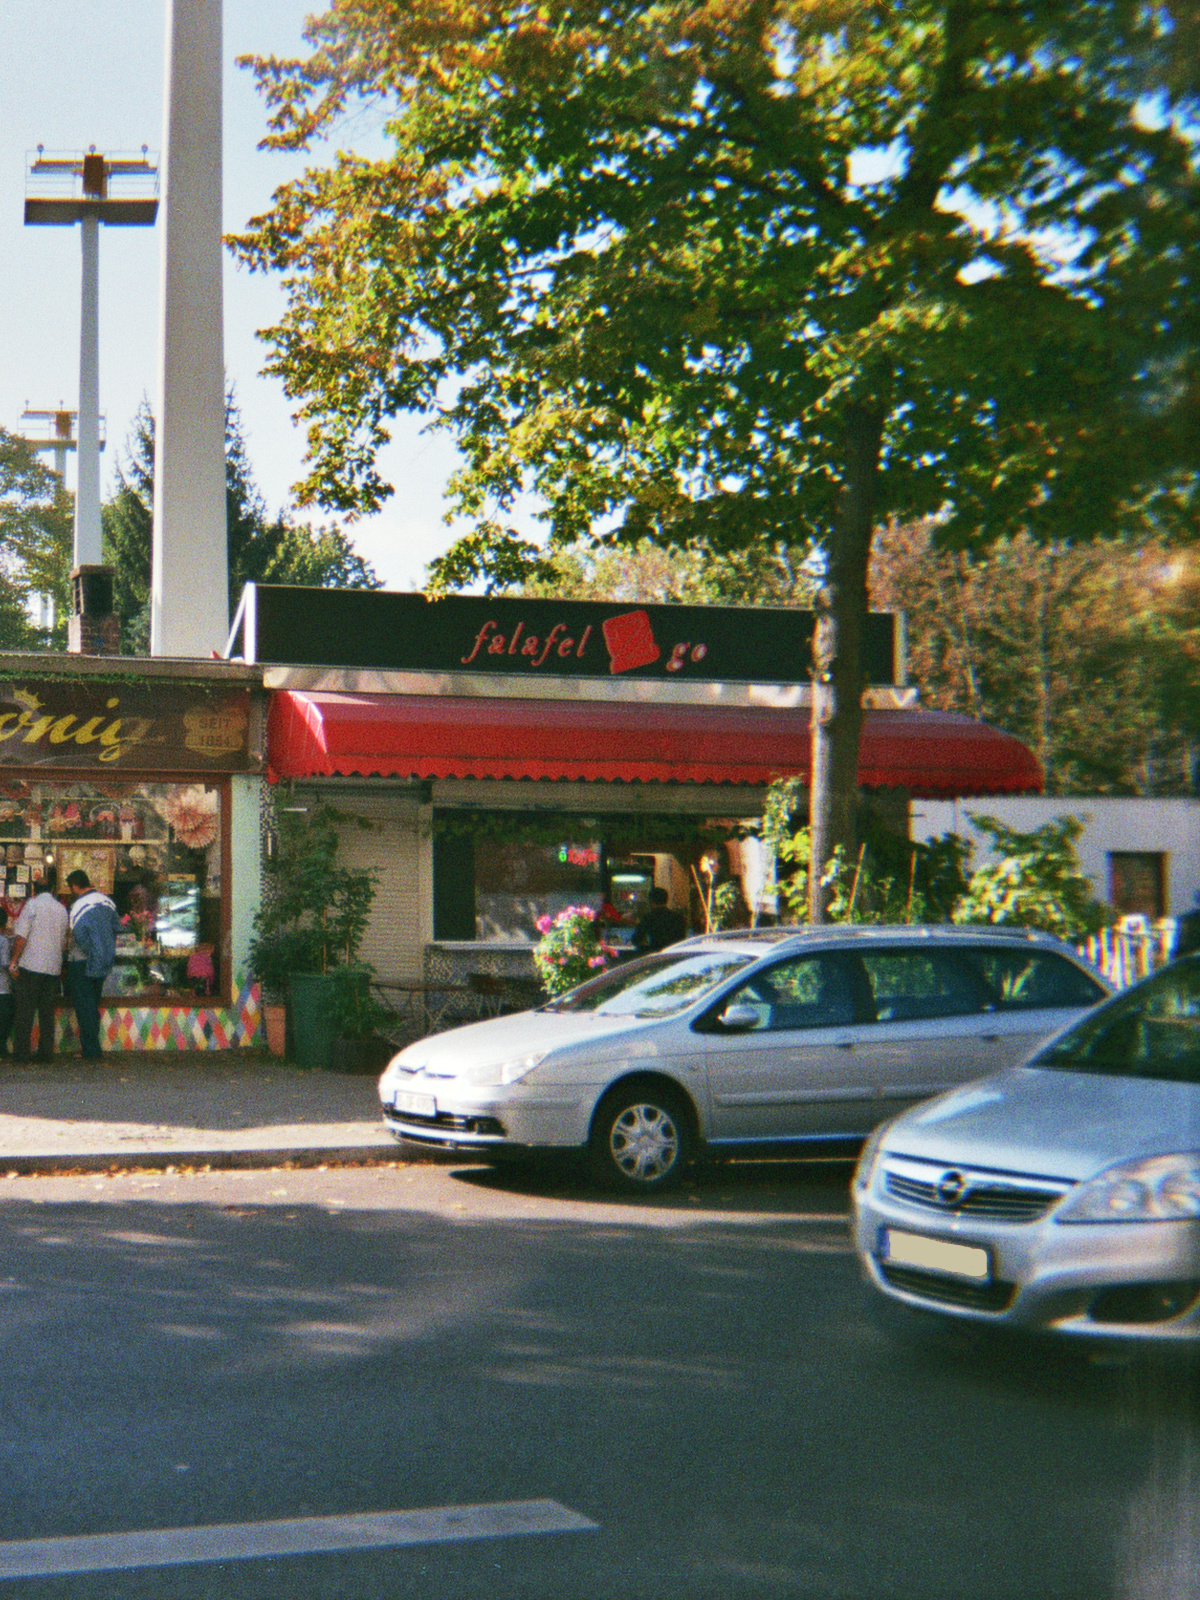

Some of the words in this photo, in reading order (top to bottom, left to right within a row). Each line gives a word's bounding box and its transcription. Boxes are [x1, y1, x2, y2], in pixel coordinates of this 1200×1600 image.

[461, 621, 592, 667] falafel
[665, 641, 708, 671] go
[198, 717, 232, 729] SEIT
